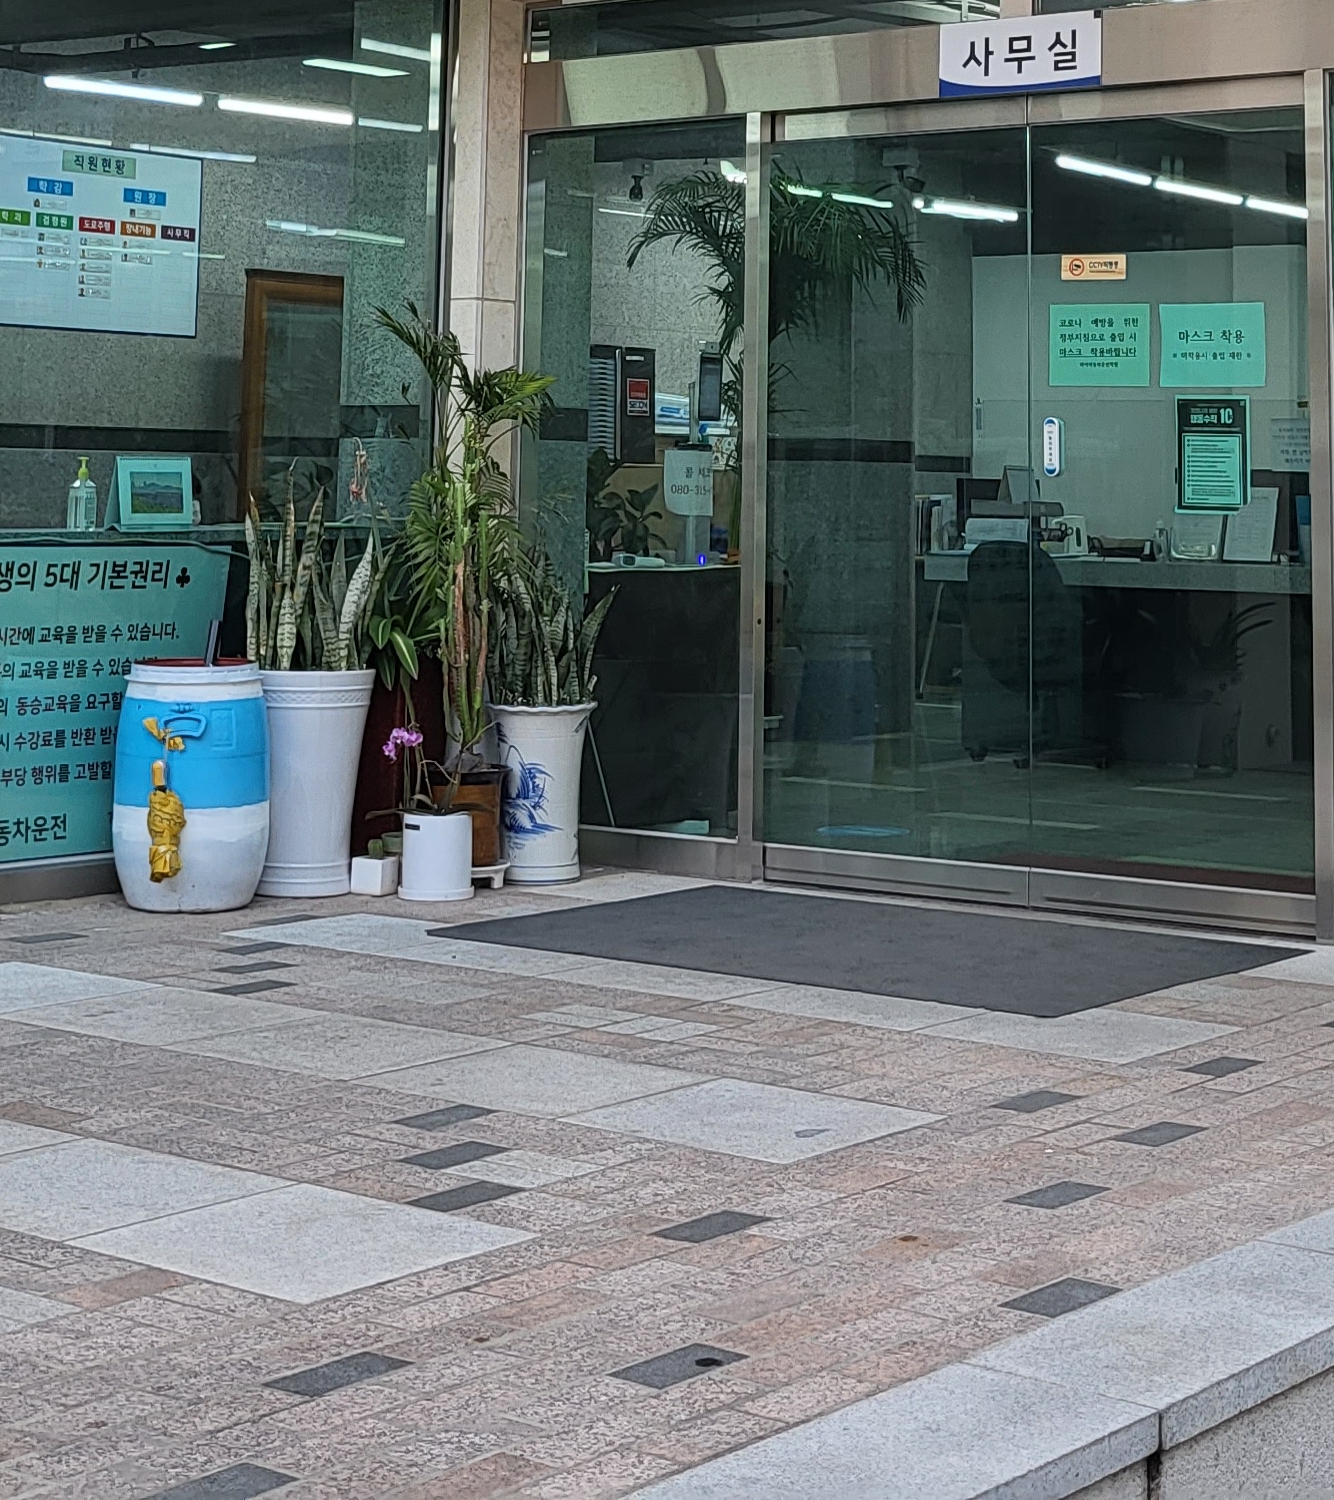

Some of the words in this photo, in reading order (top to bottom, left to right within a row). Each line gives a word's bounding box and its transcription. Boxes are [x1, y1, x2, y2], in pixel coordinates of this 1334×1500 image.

[962, 29, 1078, 77] 사무실
[73, 154, 125, 175] 직원현황
[1178, 329, 1214, 344] 마스크
[1220, 329, 1245, 344] 착용
[43, 560, 81, 590] 5대
[87, 559, 170, 590] 기본권리
[37, 625, 78, 644] 교육을
[81, 624, 107, 643] 받을
[110, 624, 123, 642] 수
[127, 621, 179, 641] 있습니다.
[17, 660, 59, 679] 교육을
[62, 658, 88, 678] 받을
[91, 658, 104, 677] 수
[15, 693, 82, 716] 동승교육을
[84, 690, 123, 711] 요구할
[13, 728, 67, 751] 수강료를
[70, 726, 96, 746] 반환
[30, 763, 70, 785] 행위를
[73, 755, 114, 780] 고발할
